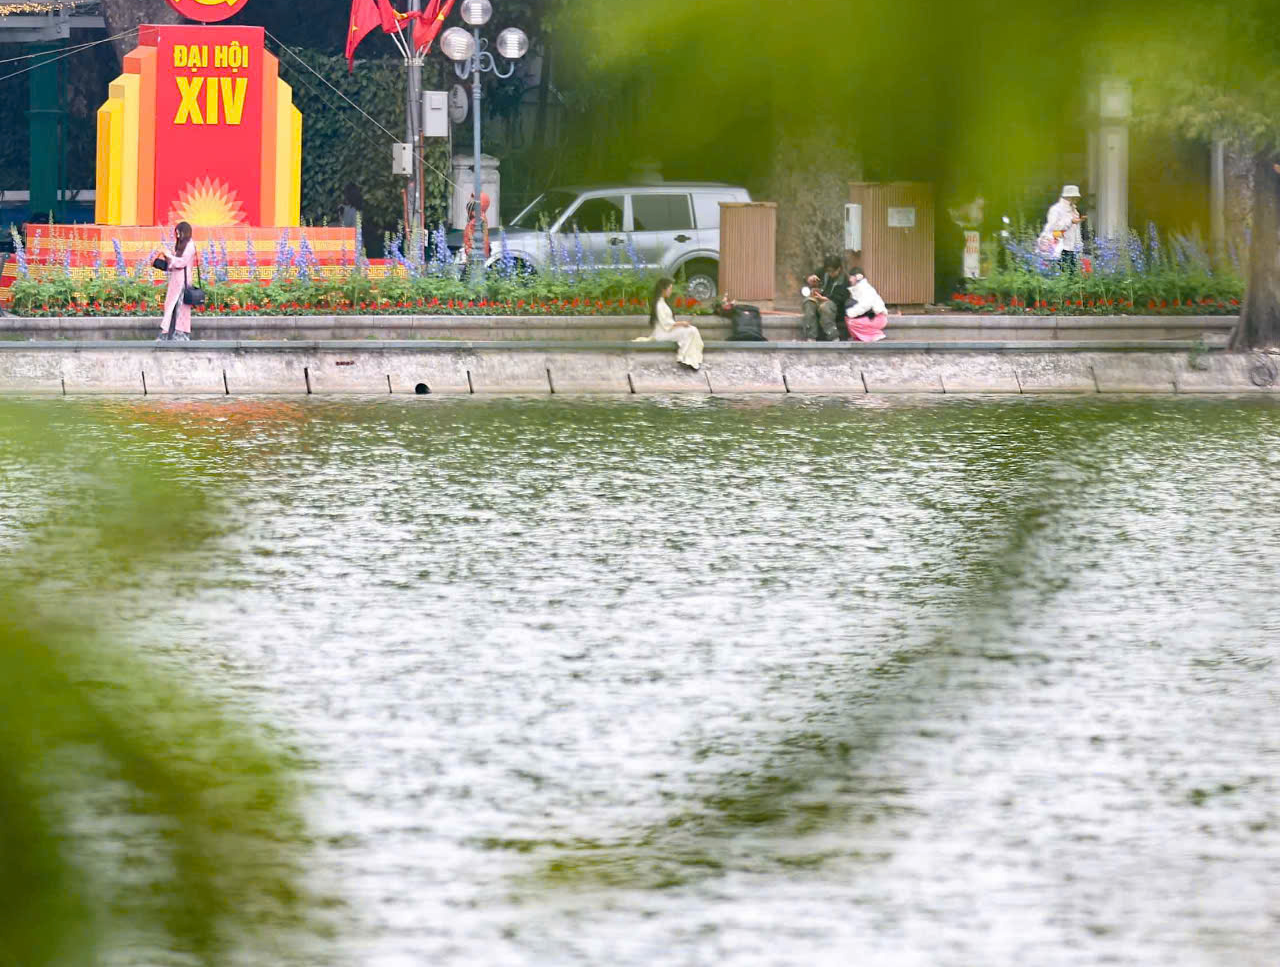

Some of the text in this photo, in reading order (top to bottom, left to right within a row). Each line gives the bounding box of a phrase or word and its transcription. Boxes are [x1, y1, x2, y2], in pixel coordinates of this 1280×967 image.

[173, 40, 249, 73] ĐẠI HỘI
[174, 76, 249, 125] XIV
